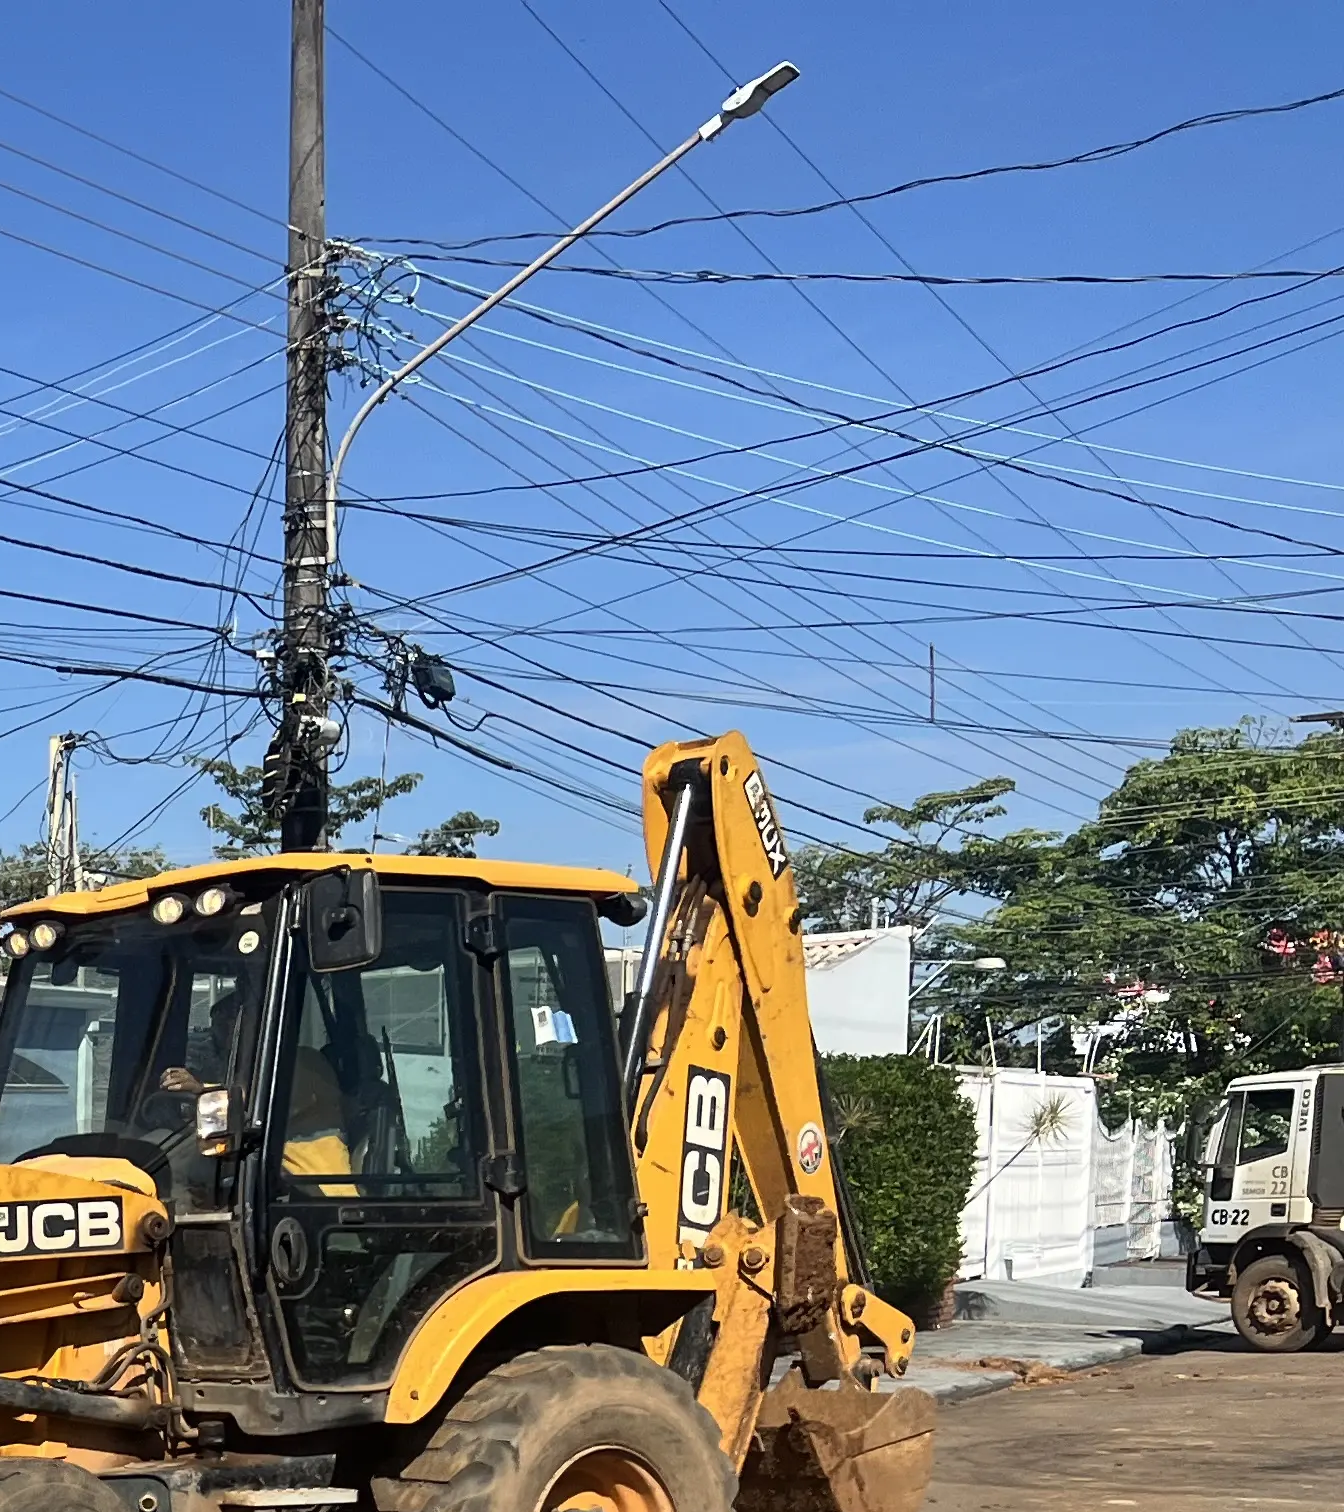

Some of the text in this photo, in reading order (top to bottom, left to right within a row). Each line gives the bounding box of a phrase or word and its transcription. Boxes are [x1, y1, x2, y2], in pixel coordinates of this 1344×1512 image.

[1299, 1089, 1312, 1131] IVECO
[1272, 1166, 1288, 1178] CB
[1271, 1181, 1287, 1194] 22
[1211, 1209, 1250, 1225] CB-22
